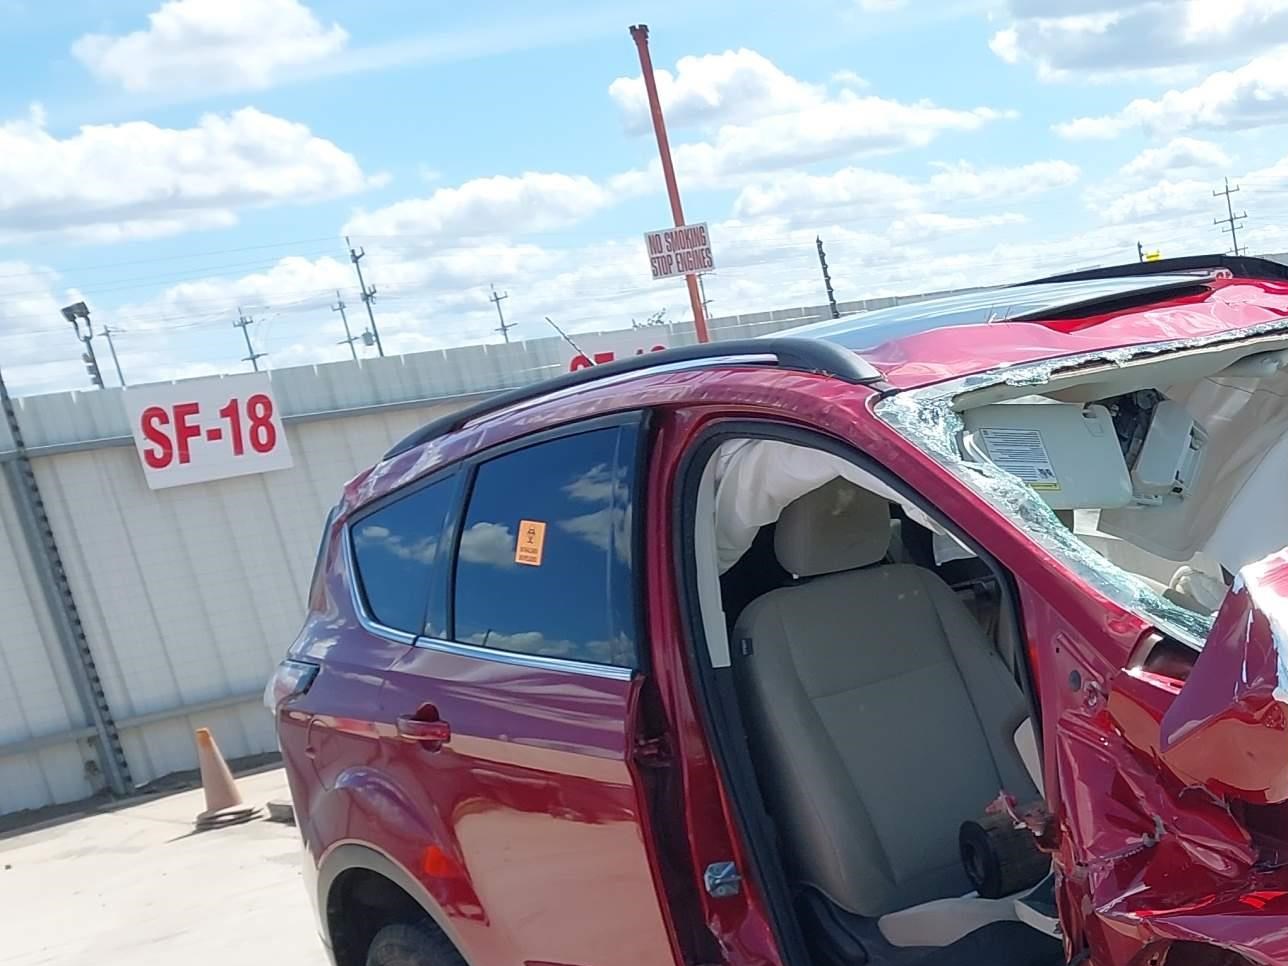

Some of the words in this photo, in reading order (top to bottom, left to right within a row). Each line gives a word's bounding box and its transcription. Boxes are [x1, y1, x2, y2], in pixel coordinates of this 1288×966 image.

[647, 233, 663, 255] NO
[664, 225, 707, 253] SMOKING
[650, 254, 674, 277] STOP
[675, 247, 713, 273] ENGINES
[140, 393, 277, 469] SF-18
